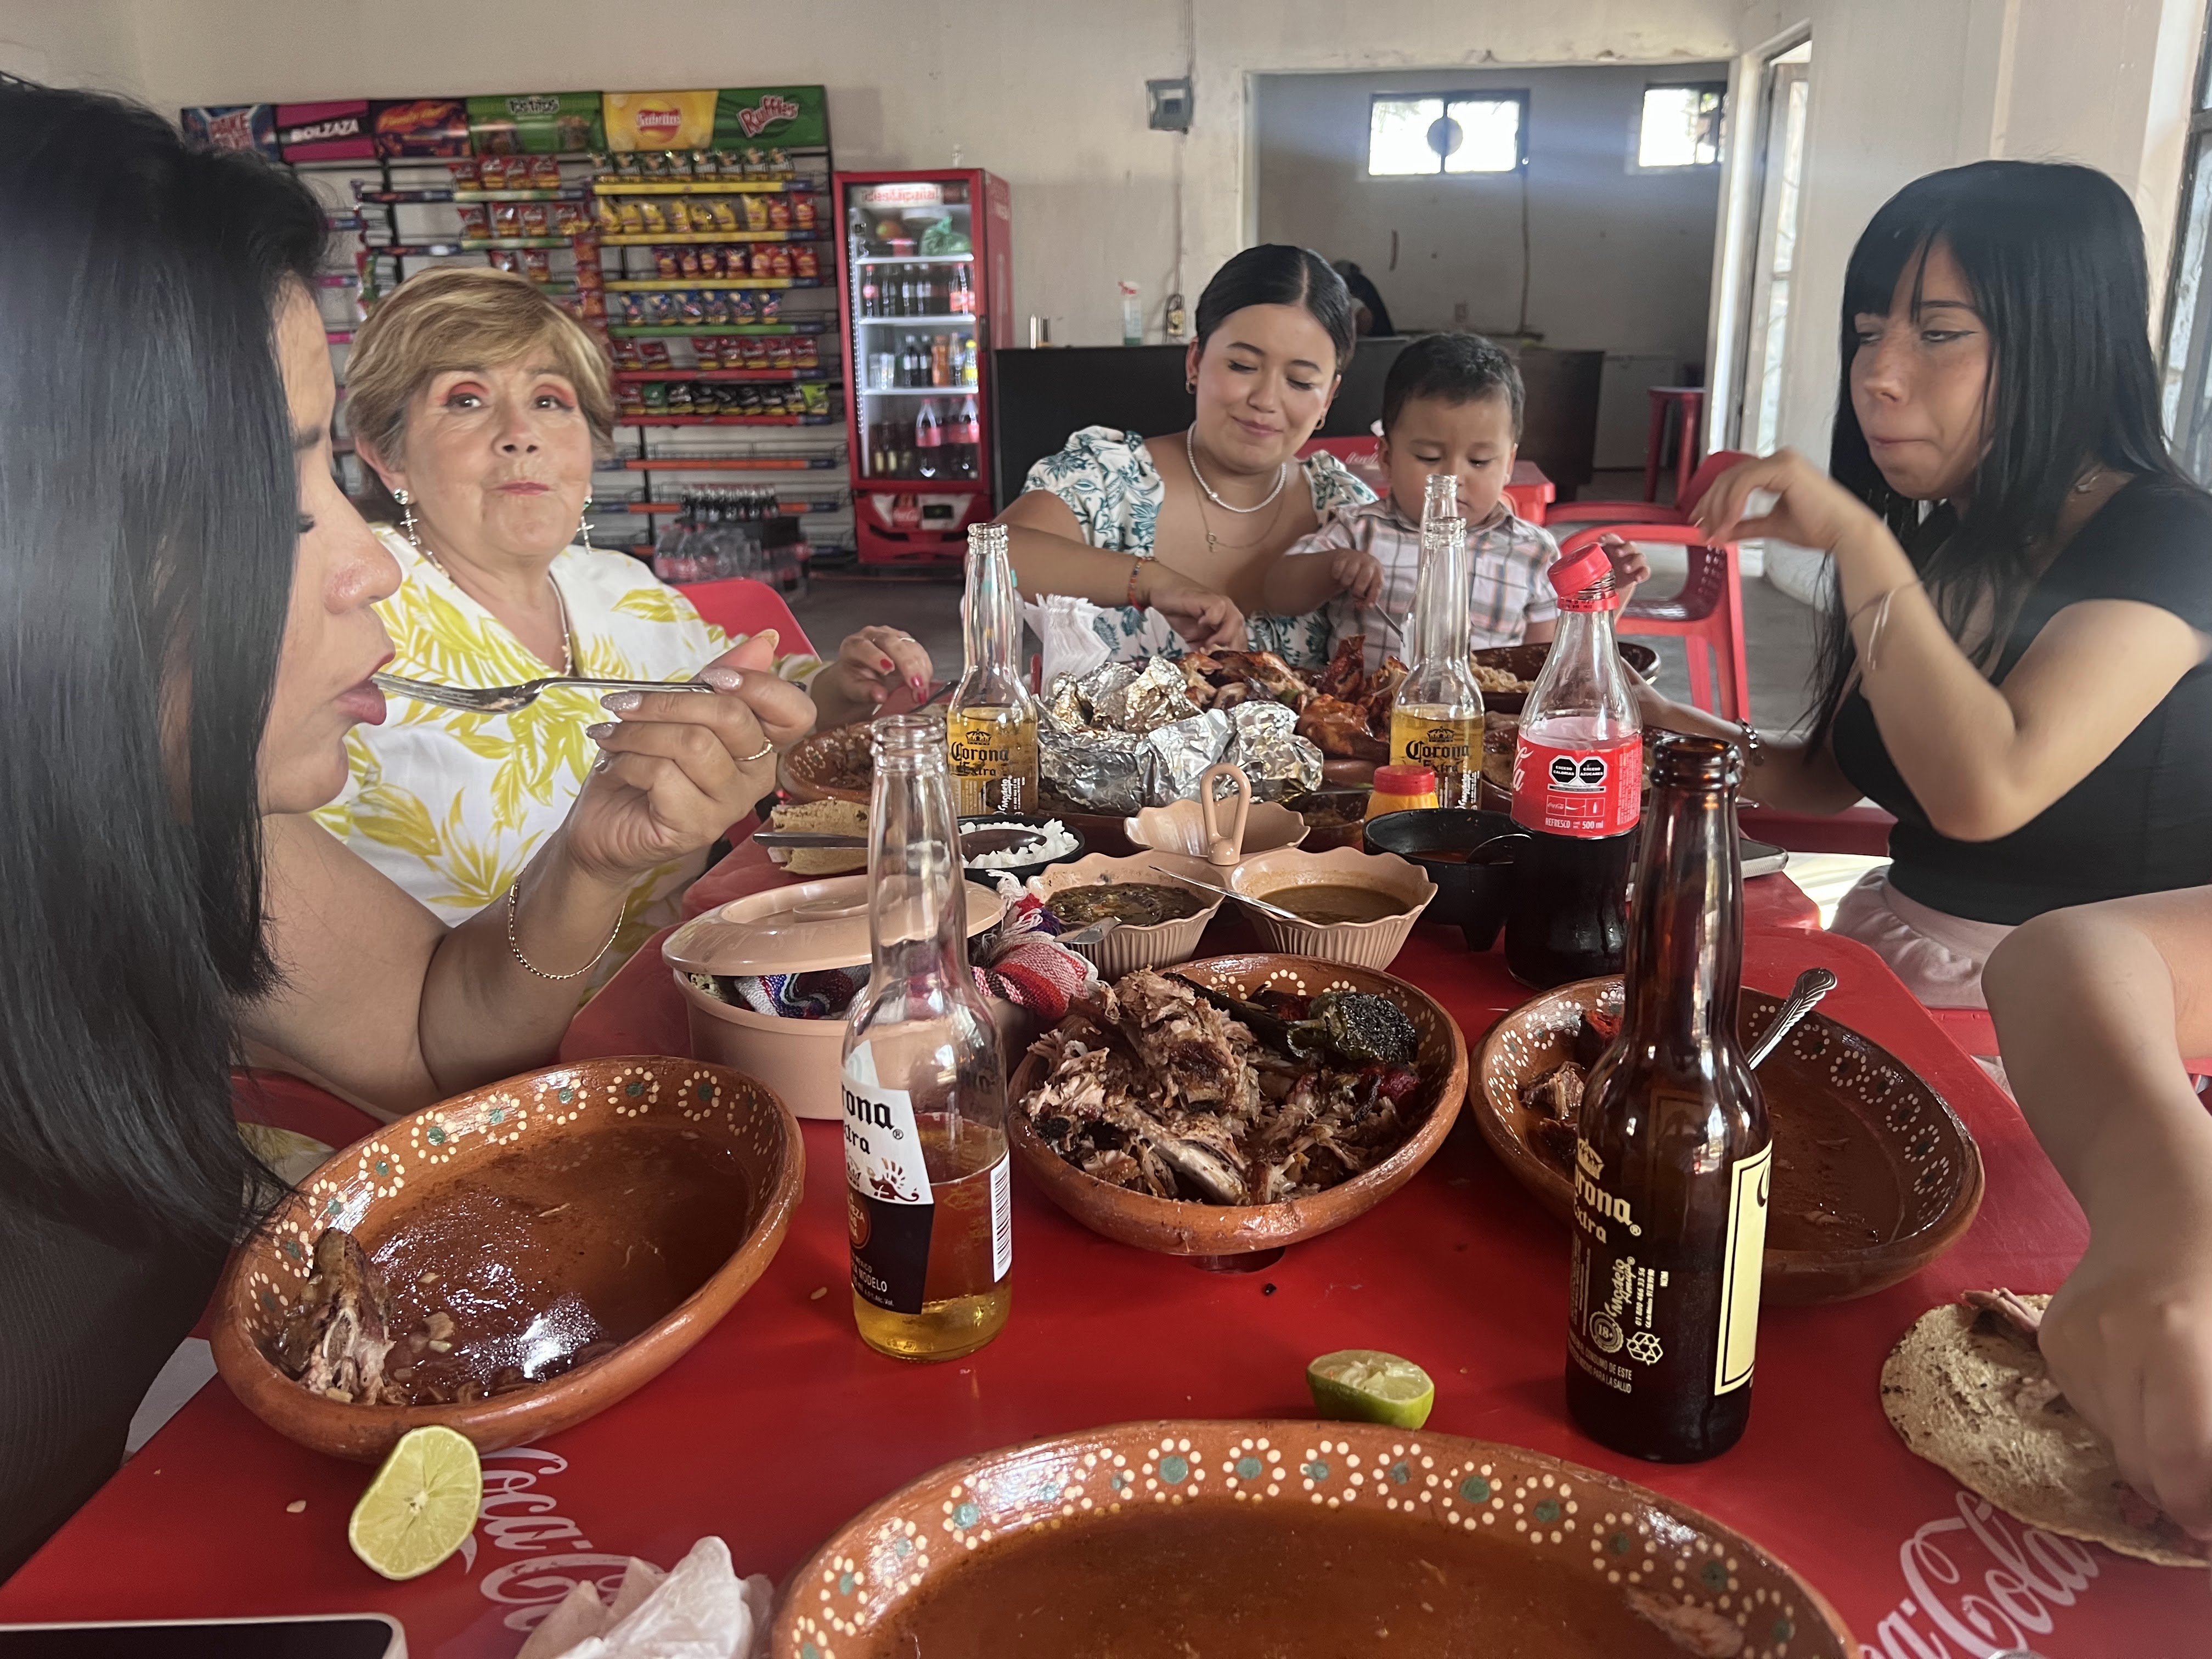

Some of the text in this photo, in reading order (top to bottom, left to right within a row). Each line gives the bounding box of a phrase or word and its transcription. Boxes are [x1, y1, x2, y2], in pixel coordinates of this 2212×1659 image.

[637, 112, 680, 127] Sabritas
[737, 95, 798, 136] Ruffles
[951, 741, 1009, 761] Corona
[1406, 740, 1469, 763] Corona
[1545, 817, 1571, 828] REFRESCO
[1582, 820, 1595, 829] 500
[1595, 820, 1604, 829] ml
[1575, 1164, 1633, 1226] rona
[859, 1268, 888, 1293] MODELO
[1604, 1258, 1625, 1317] Modelo
[1609, 1362, 1616, 1374] DE
[1617, 1366, 1632, 1380] ESTE
[1613, 1378, 1632, 1393] SALUD
